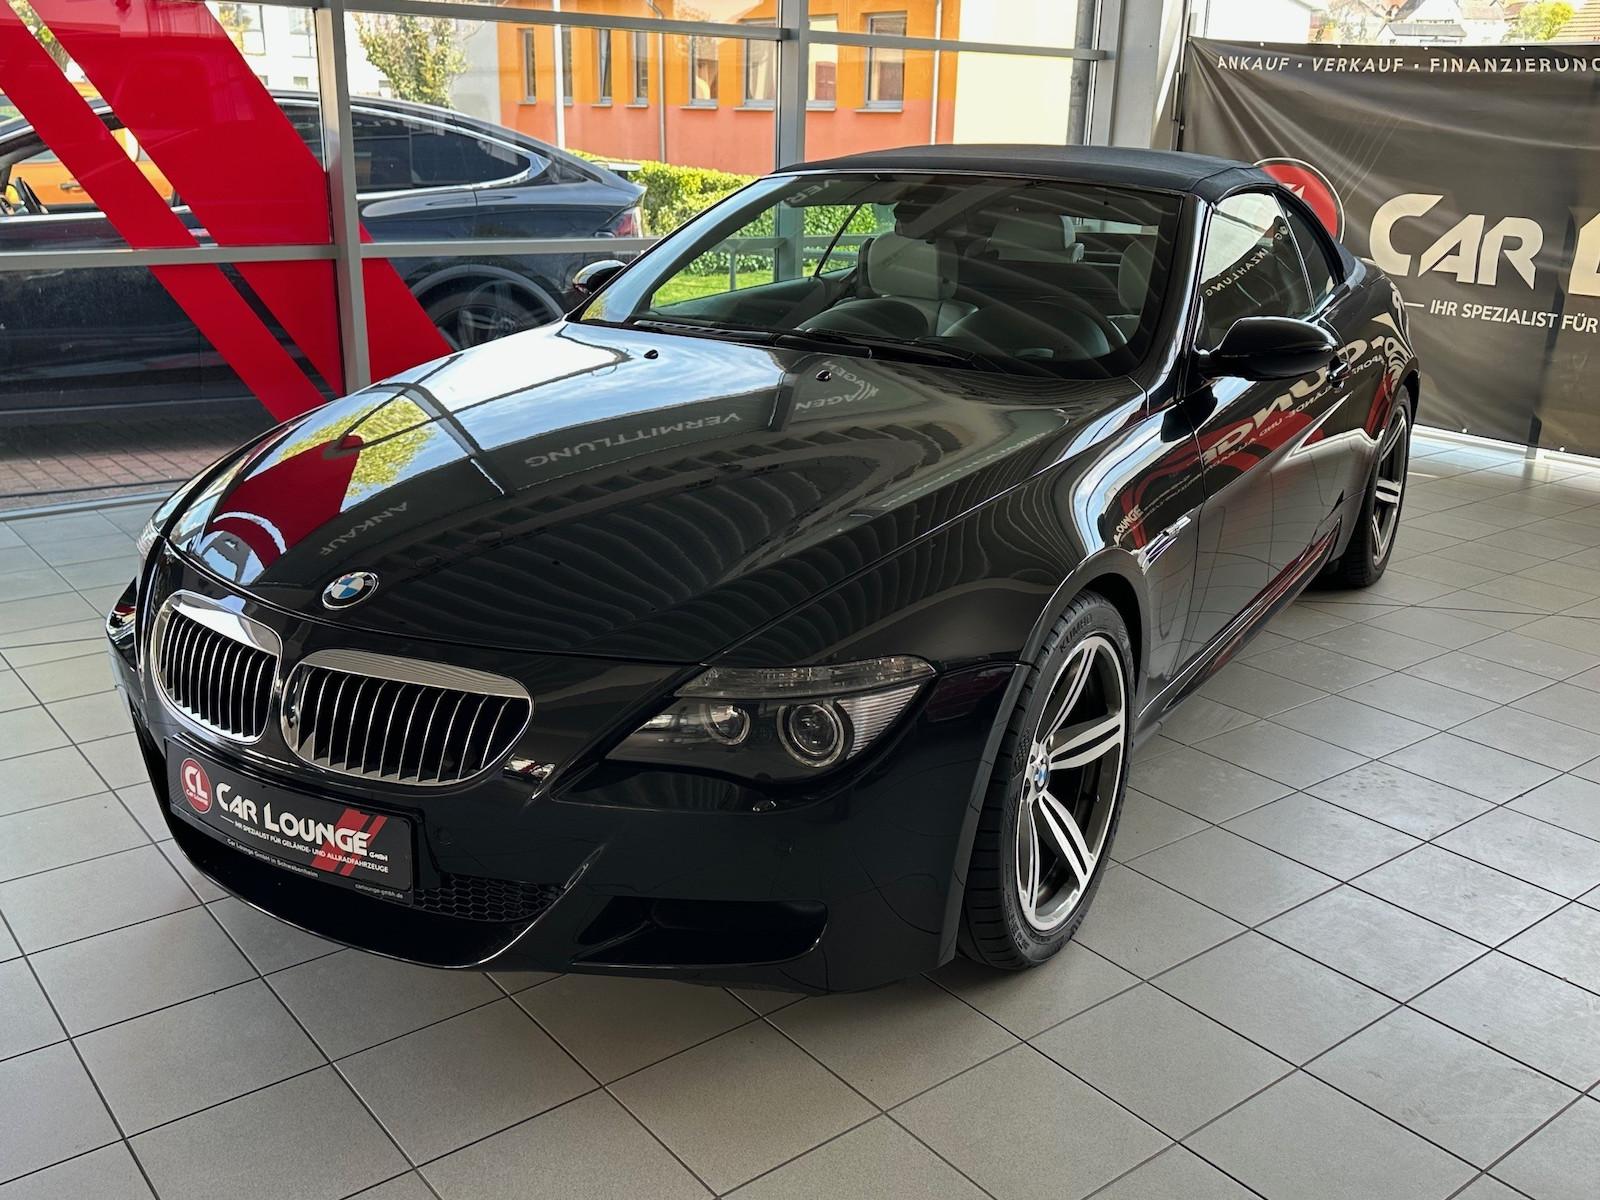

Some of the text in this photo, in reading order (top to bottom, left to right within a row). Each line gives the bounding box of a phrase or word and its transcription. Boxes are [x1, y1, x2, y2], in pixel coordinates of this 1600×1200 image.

[1217, 55, 1290, 71] ANKAUF
[1312, 57, 1404, 73] VERKAUF
[1369, 193, 1544, 290] CAR
[1430, 299, 1599, 334] IHR SPEZIALIST FÜR
[524, 412, 742, 468] VERMITTLUNG
[319, 501, 408, 557] ANKAUF
[184, 765, 208, 800] CL
[216, 782, 258, 824] CAR
[263, 802, 371, 857] LOUNGE
[243, 825, 270, 841] SPEZIALIST
[312, 849, 326, 857] UND
[327, 853, 389, 873] ALLRADFAHRZEUGE
